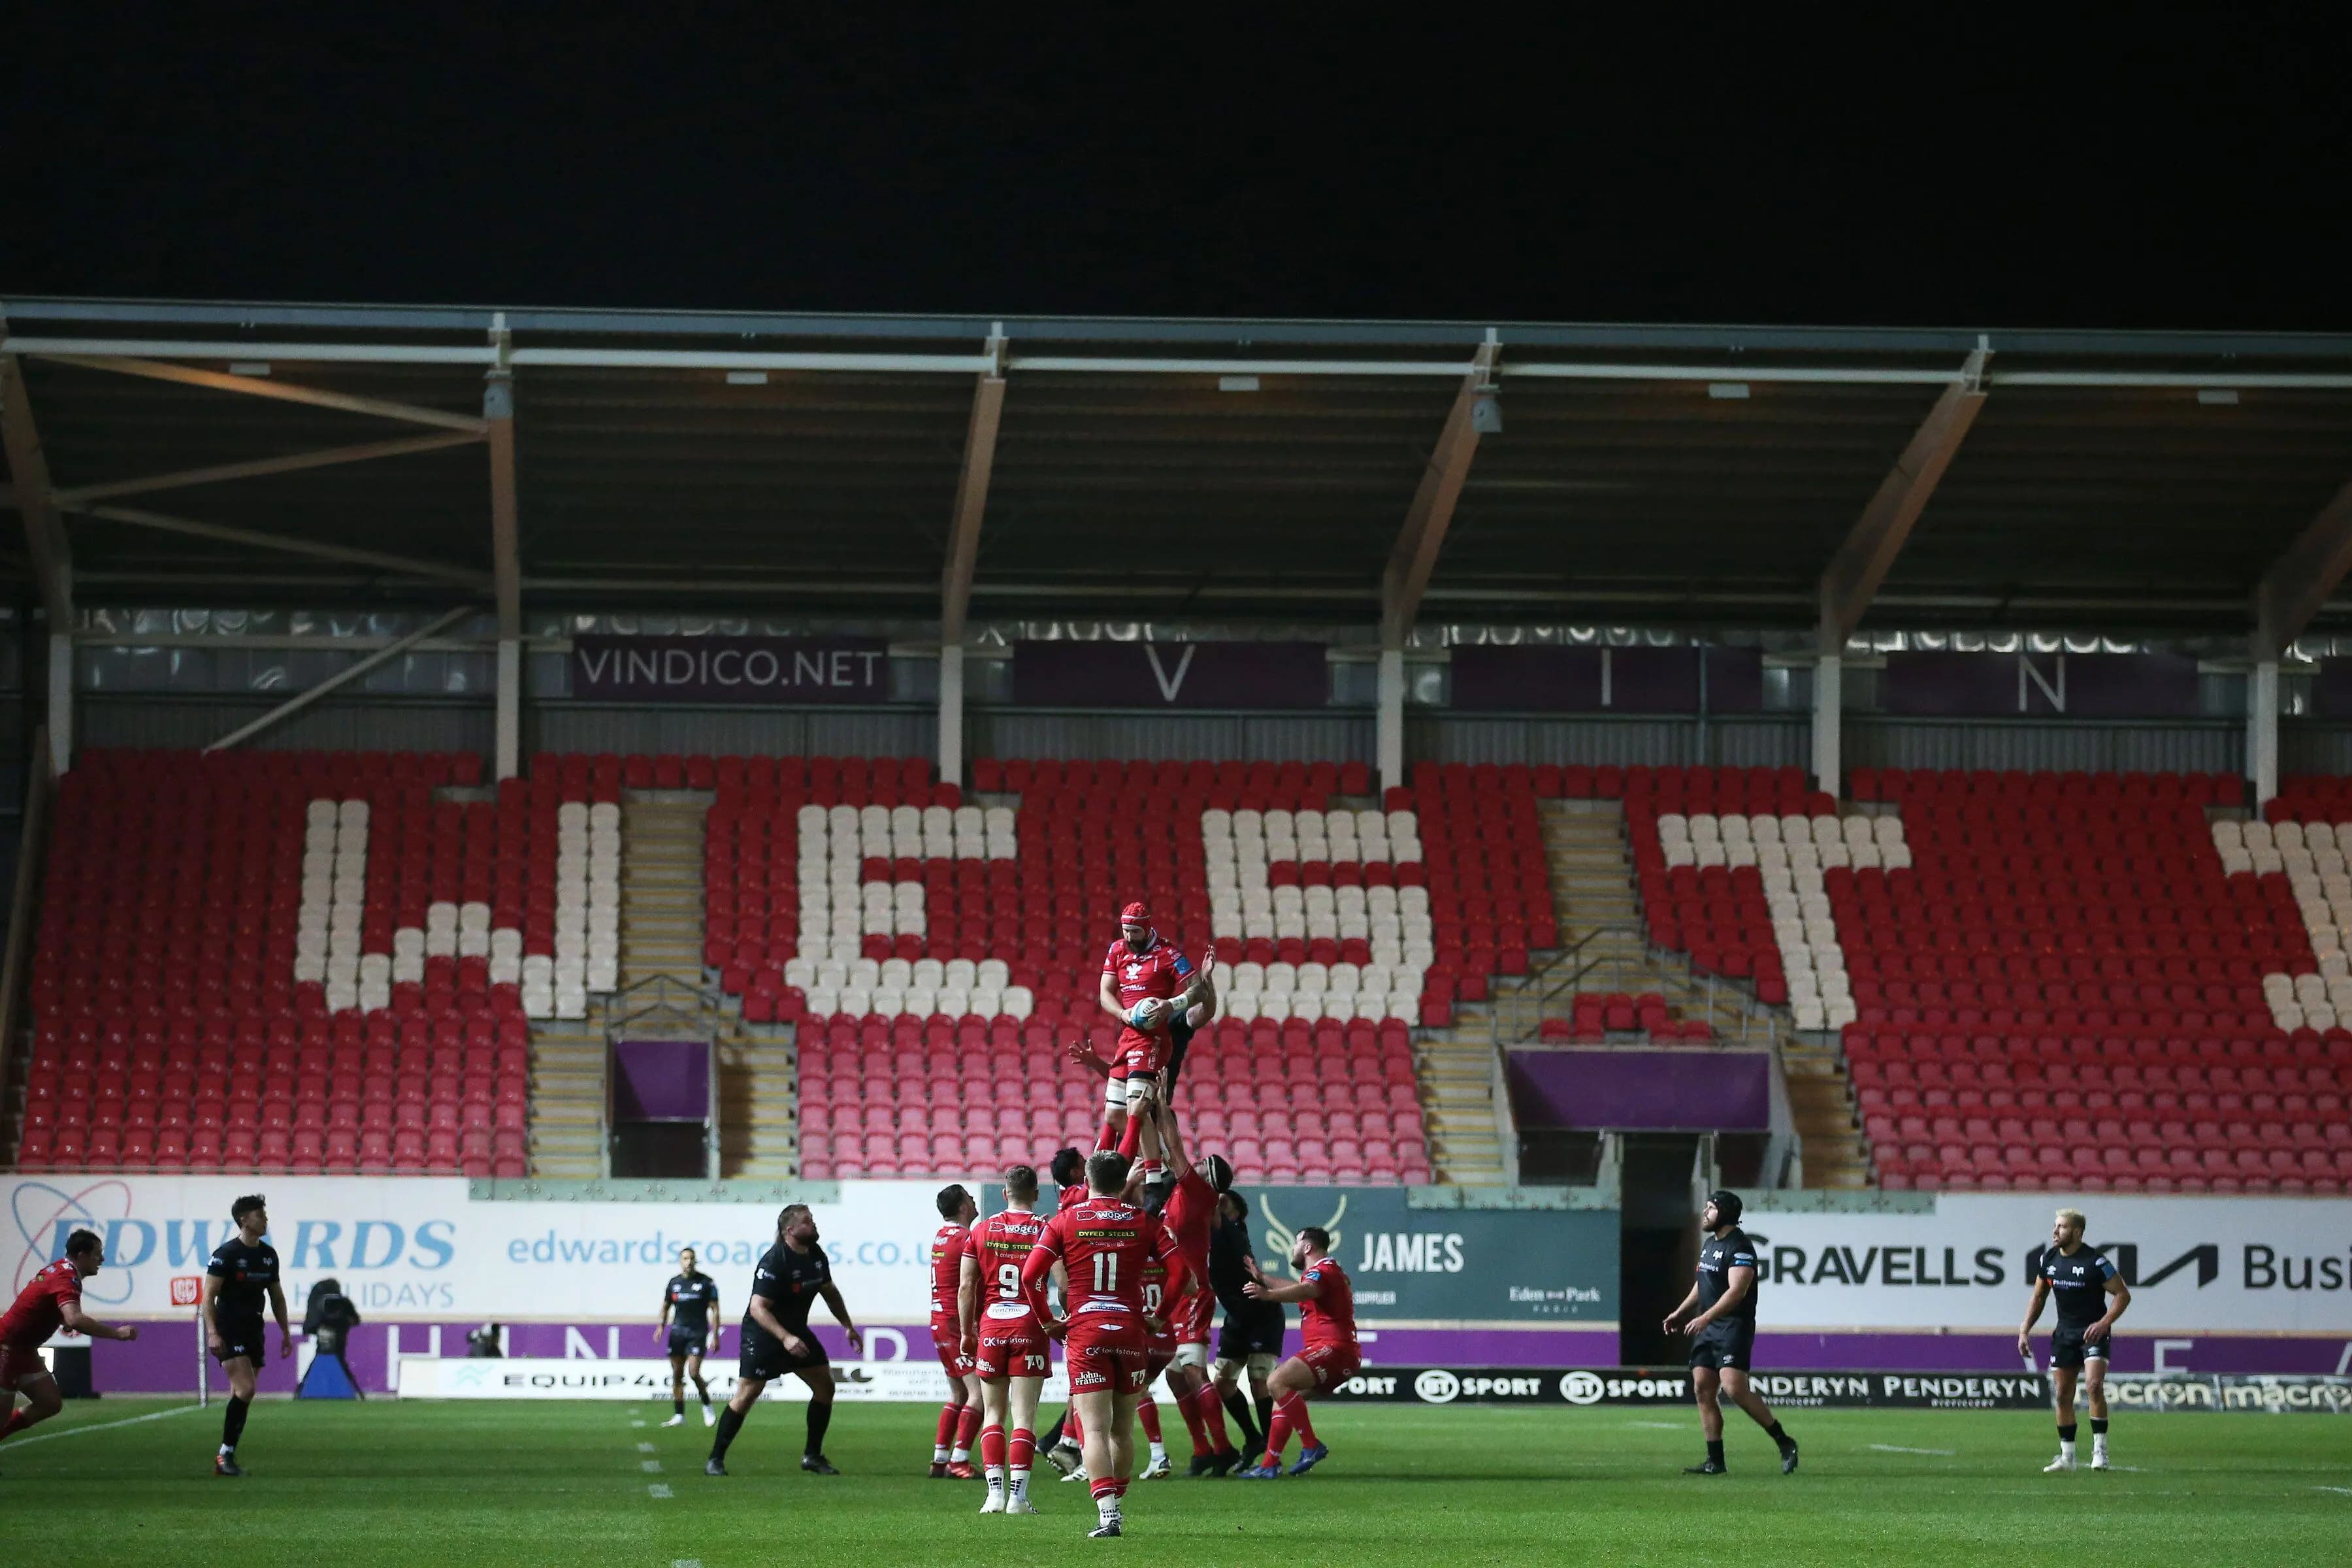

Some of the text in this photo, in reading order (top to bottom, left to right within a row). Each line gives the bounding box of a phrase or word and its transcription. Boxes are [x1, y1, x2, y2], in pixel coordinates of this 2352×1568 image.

[580, 647, 879, 687] VINDICO.NET
[1358, 1232, 1464, 1273] JAMES
[999, 1264, 1019, 1298] 9
[1093, 1252, 1118, 1292] 11
[1075, 1376, 1105, 1386] Francis
[1462, 1377, 1541, 1396] SPORT
[1607, 1379, 1686, 1398] SPORT
[1883, 1376, 2040, 1398] PENDERYN
